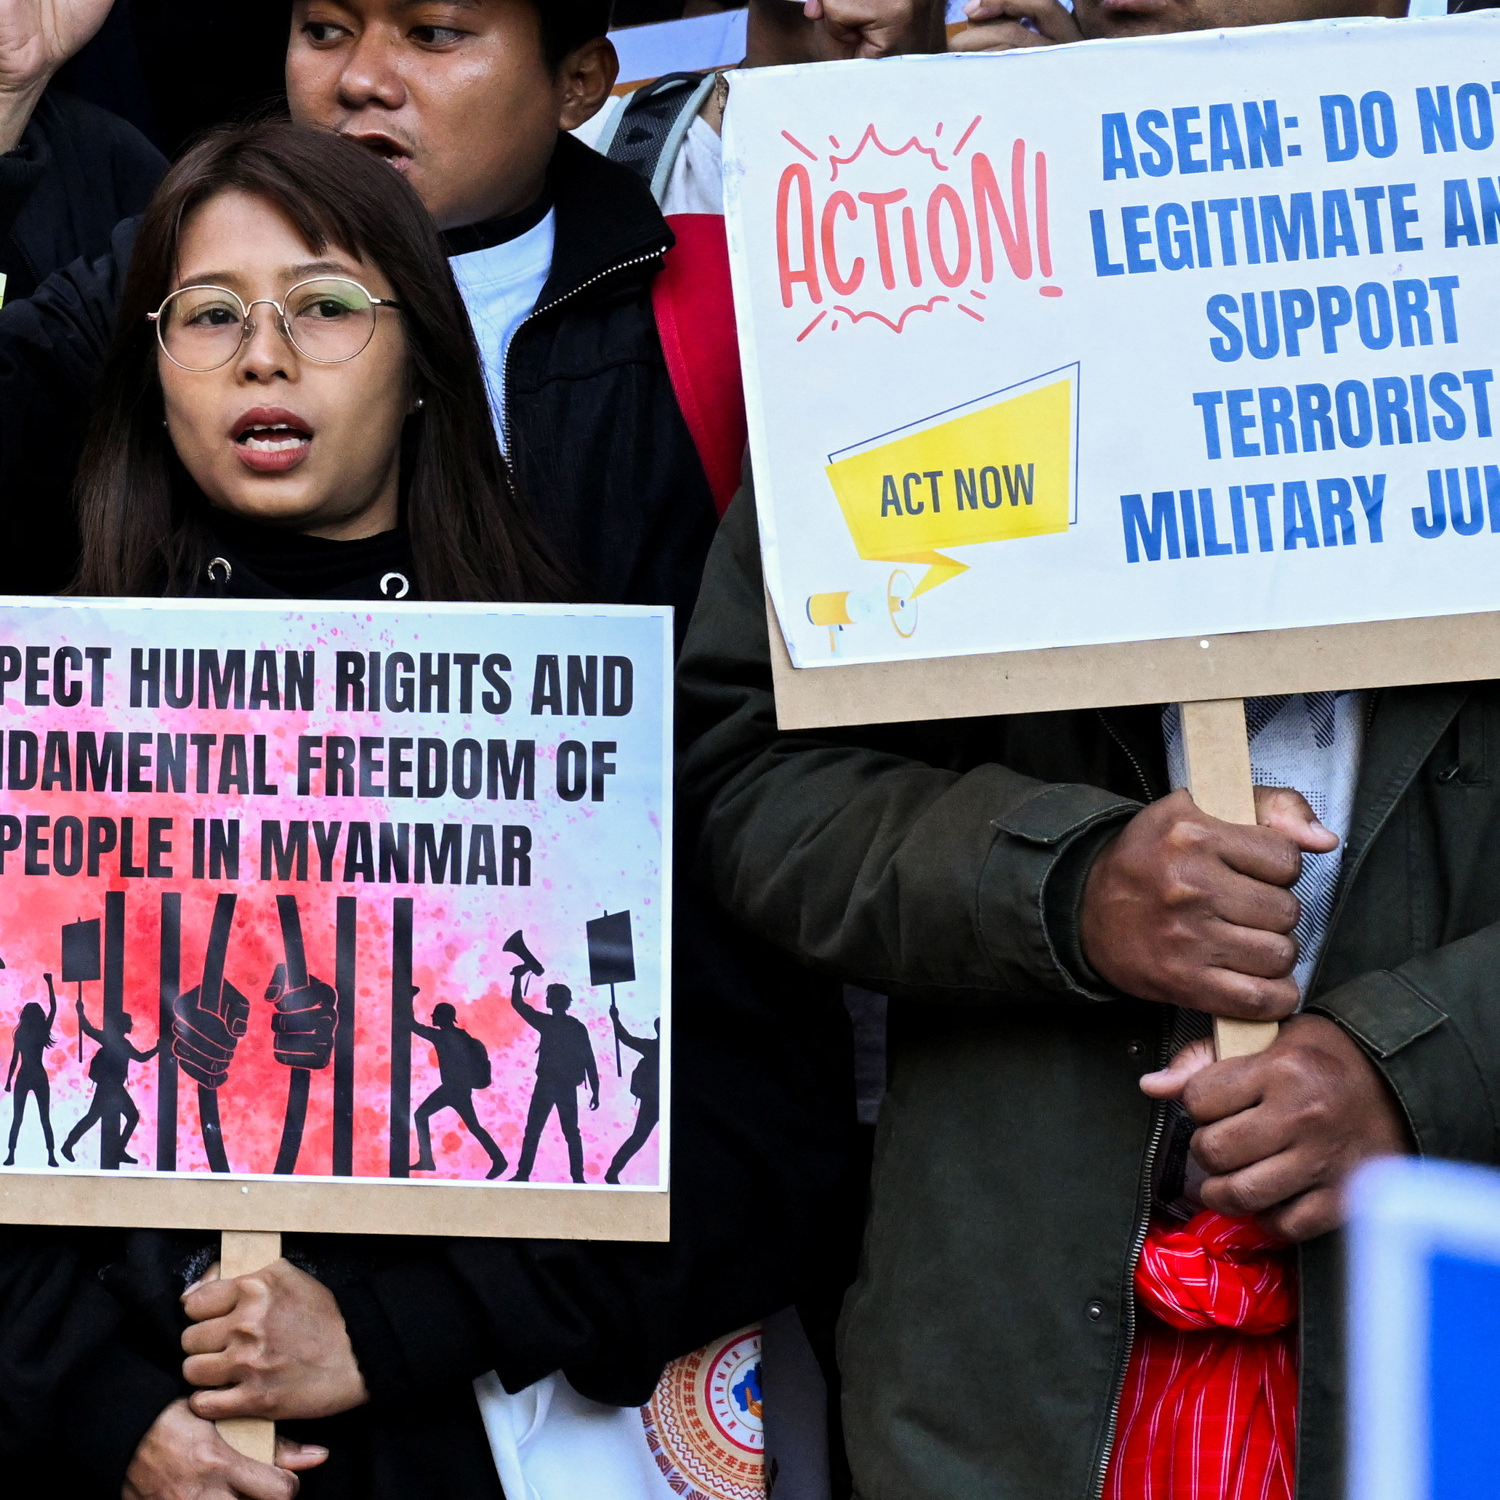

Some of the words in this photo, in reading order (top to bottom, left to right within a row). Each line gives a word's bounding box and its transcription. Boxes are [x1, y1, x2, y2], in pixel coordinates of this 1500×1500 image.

[1102, 100, 1301, 180] ASEAN:
[1320, 91, 1397, 162] DO
[1416, 81, 1500, 154] NO
[776, 138, 1063, 308] ACTION!
[1090, 184, 1423, 276] LEGITIMATE
[1207, 276, 1459, 362] SUPPORT
[1193, 369, 1493, 459] TERRORIST
[880, 469, 943, 518] ACT
[956, 463, 1035, 510] NOW
[1120, 474, 1386, 563] MILITARY
[131, 649, 314, 710] HUMAN
[336, 652, 511, 714] RIGHTS
[532, 655, 632, 715] AND
[298, 736, 534, 799] FREEDOM
[557, 741, 616, 801] OF
[193, 819, 239, 879] IN
[261, 821, 531, 885] MYANMAR
